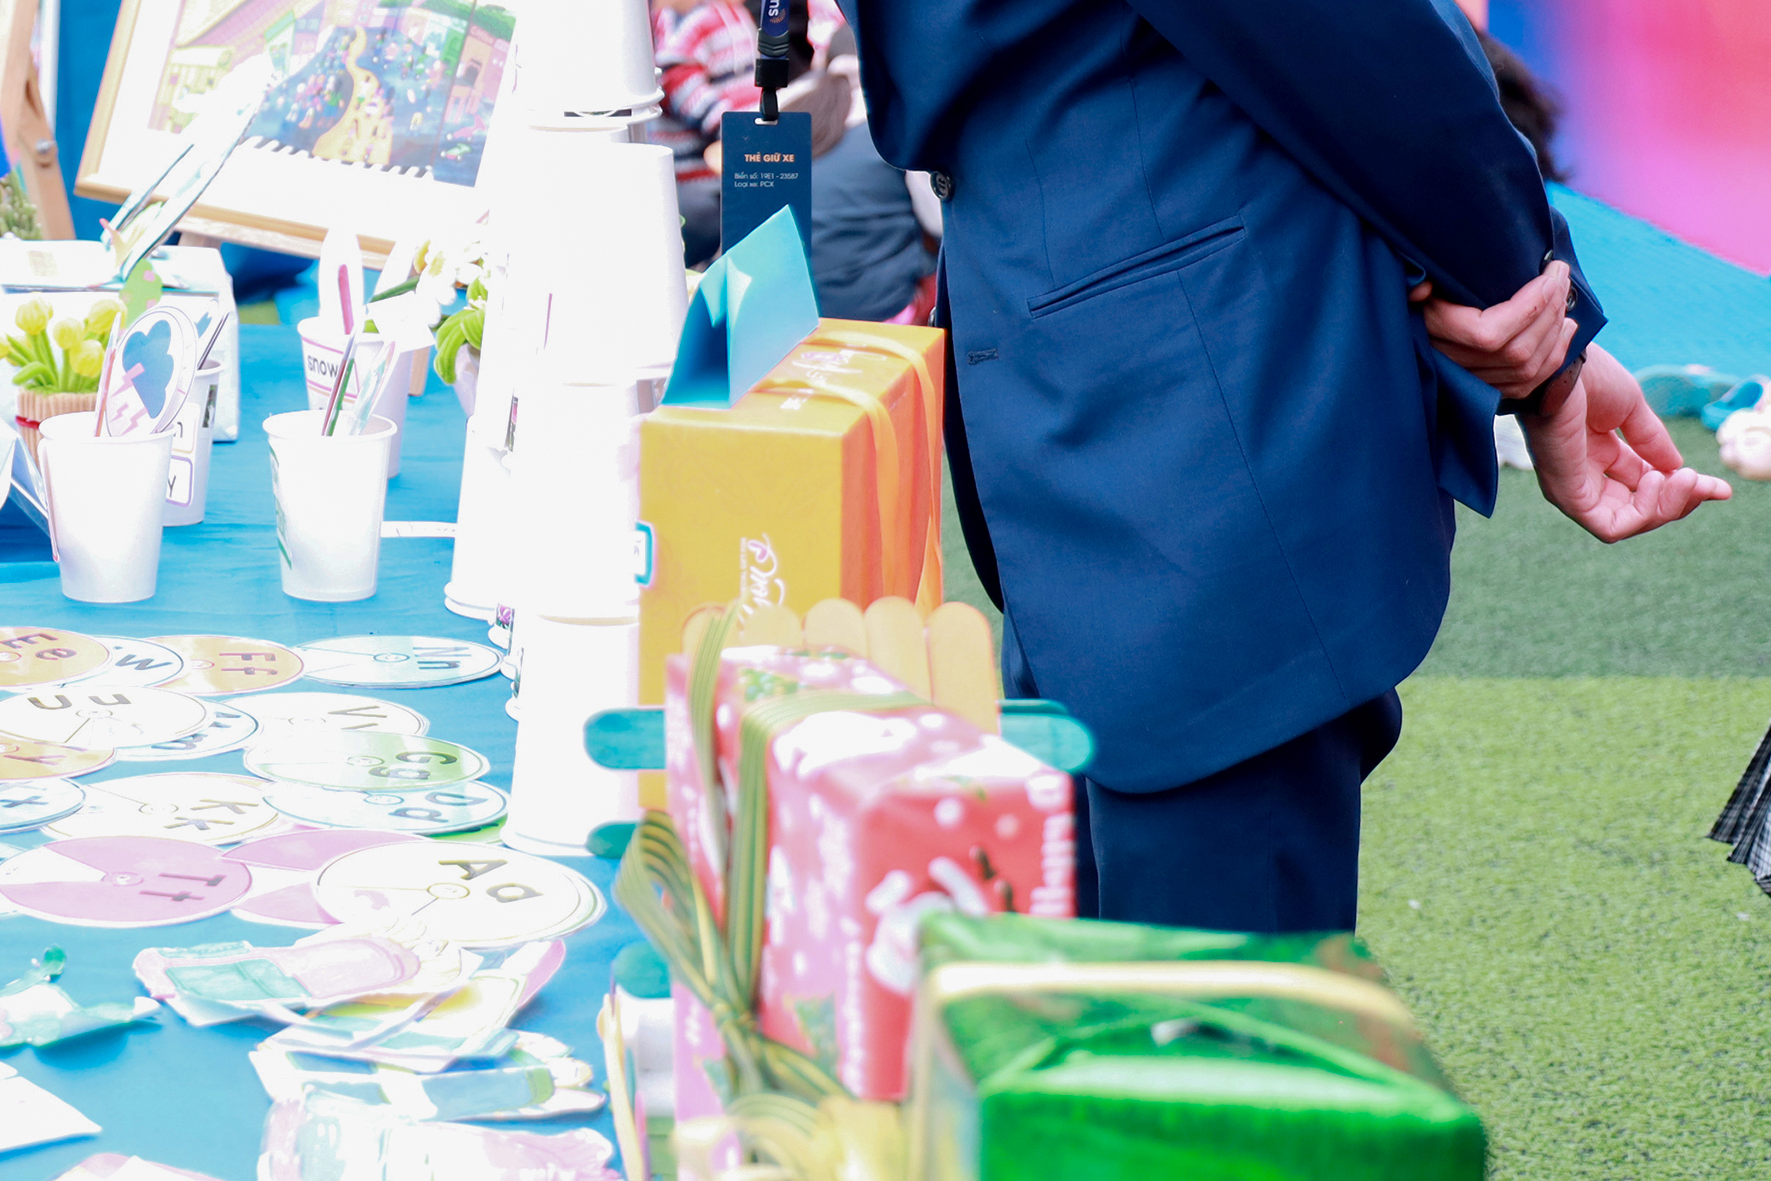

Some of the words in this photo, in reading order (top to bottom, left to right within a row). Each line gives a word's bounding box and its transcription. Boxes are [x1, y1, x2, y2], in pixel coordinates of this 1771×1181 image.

[744, 151, 761, 163] THẺ
[763, 151, 781, 163] GIỮ
[782, 154, 795, 163] XE
